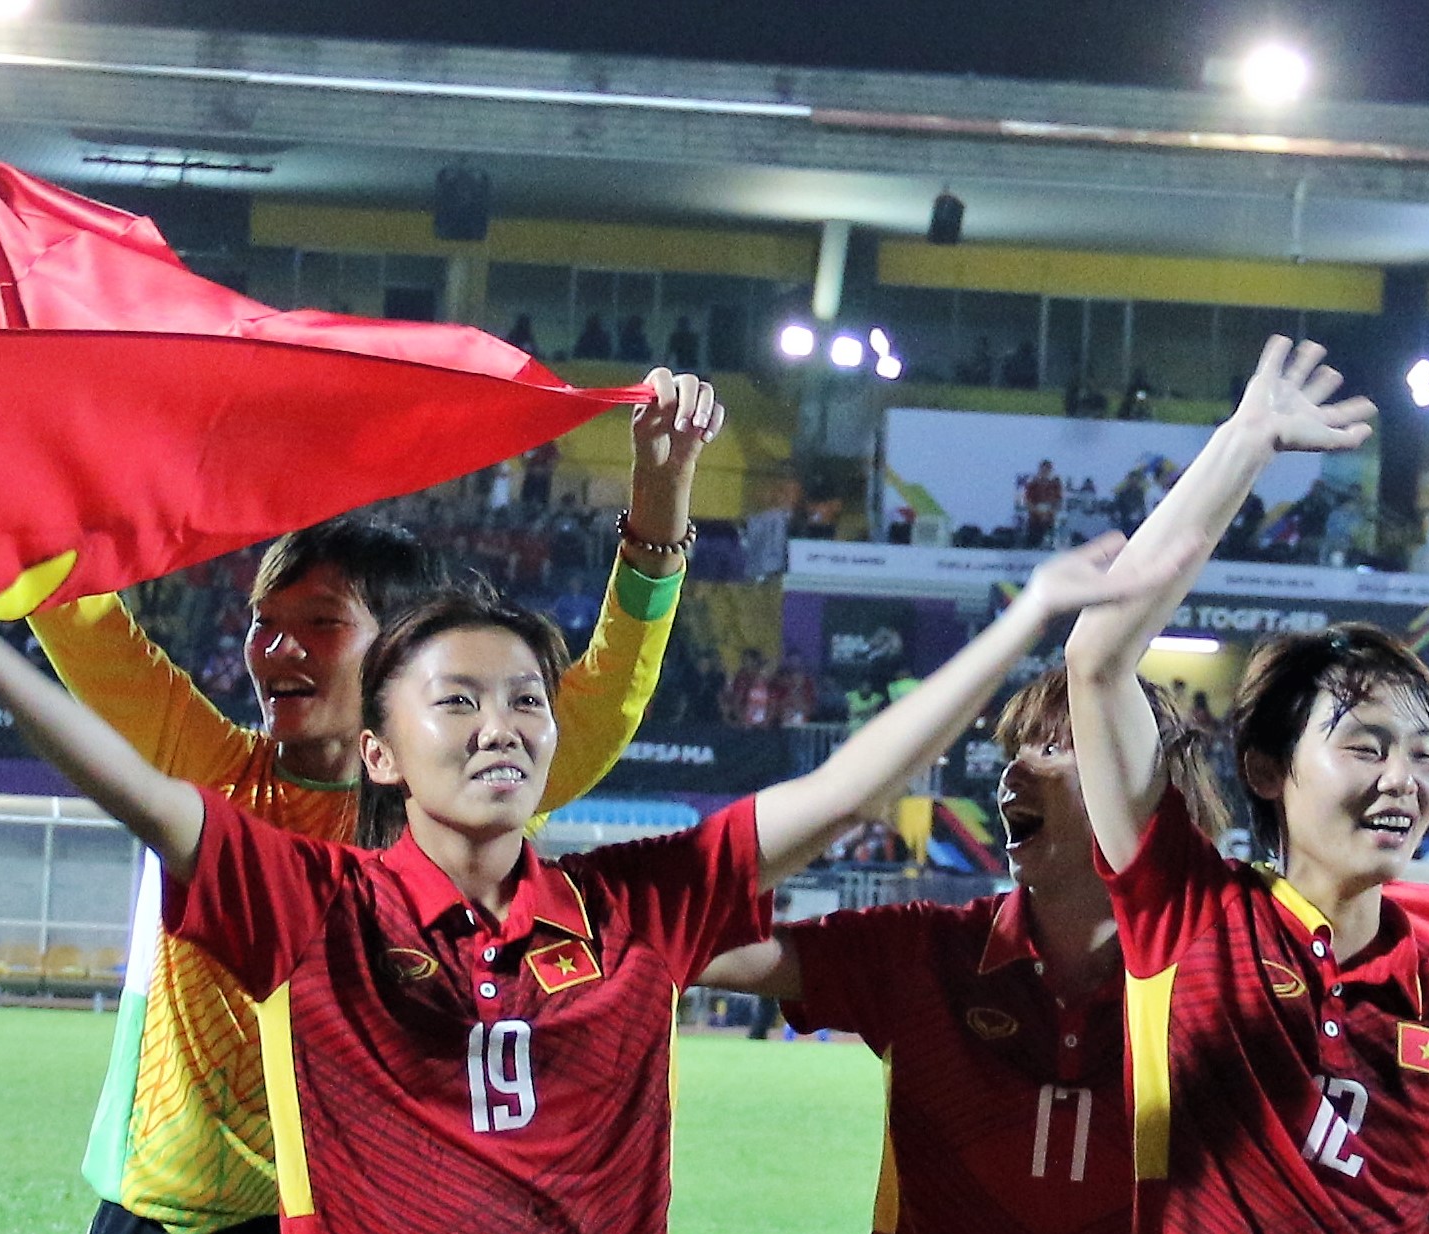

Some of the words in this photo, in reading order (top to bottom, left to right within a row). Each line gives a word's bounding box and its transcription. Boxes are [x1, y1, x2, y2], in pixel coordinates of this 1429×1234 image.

[467, 1019, 537, 1132] 19
[1302, 1074, 1369, 1178] 12
[1031, 1083, 1092, 1181] 17
